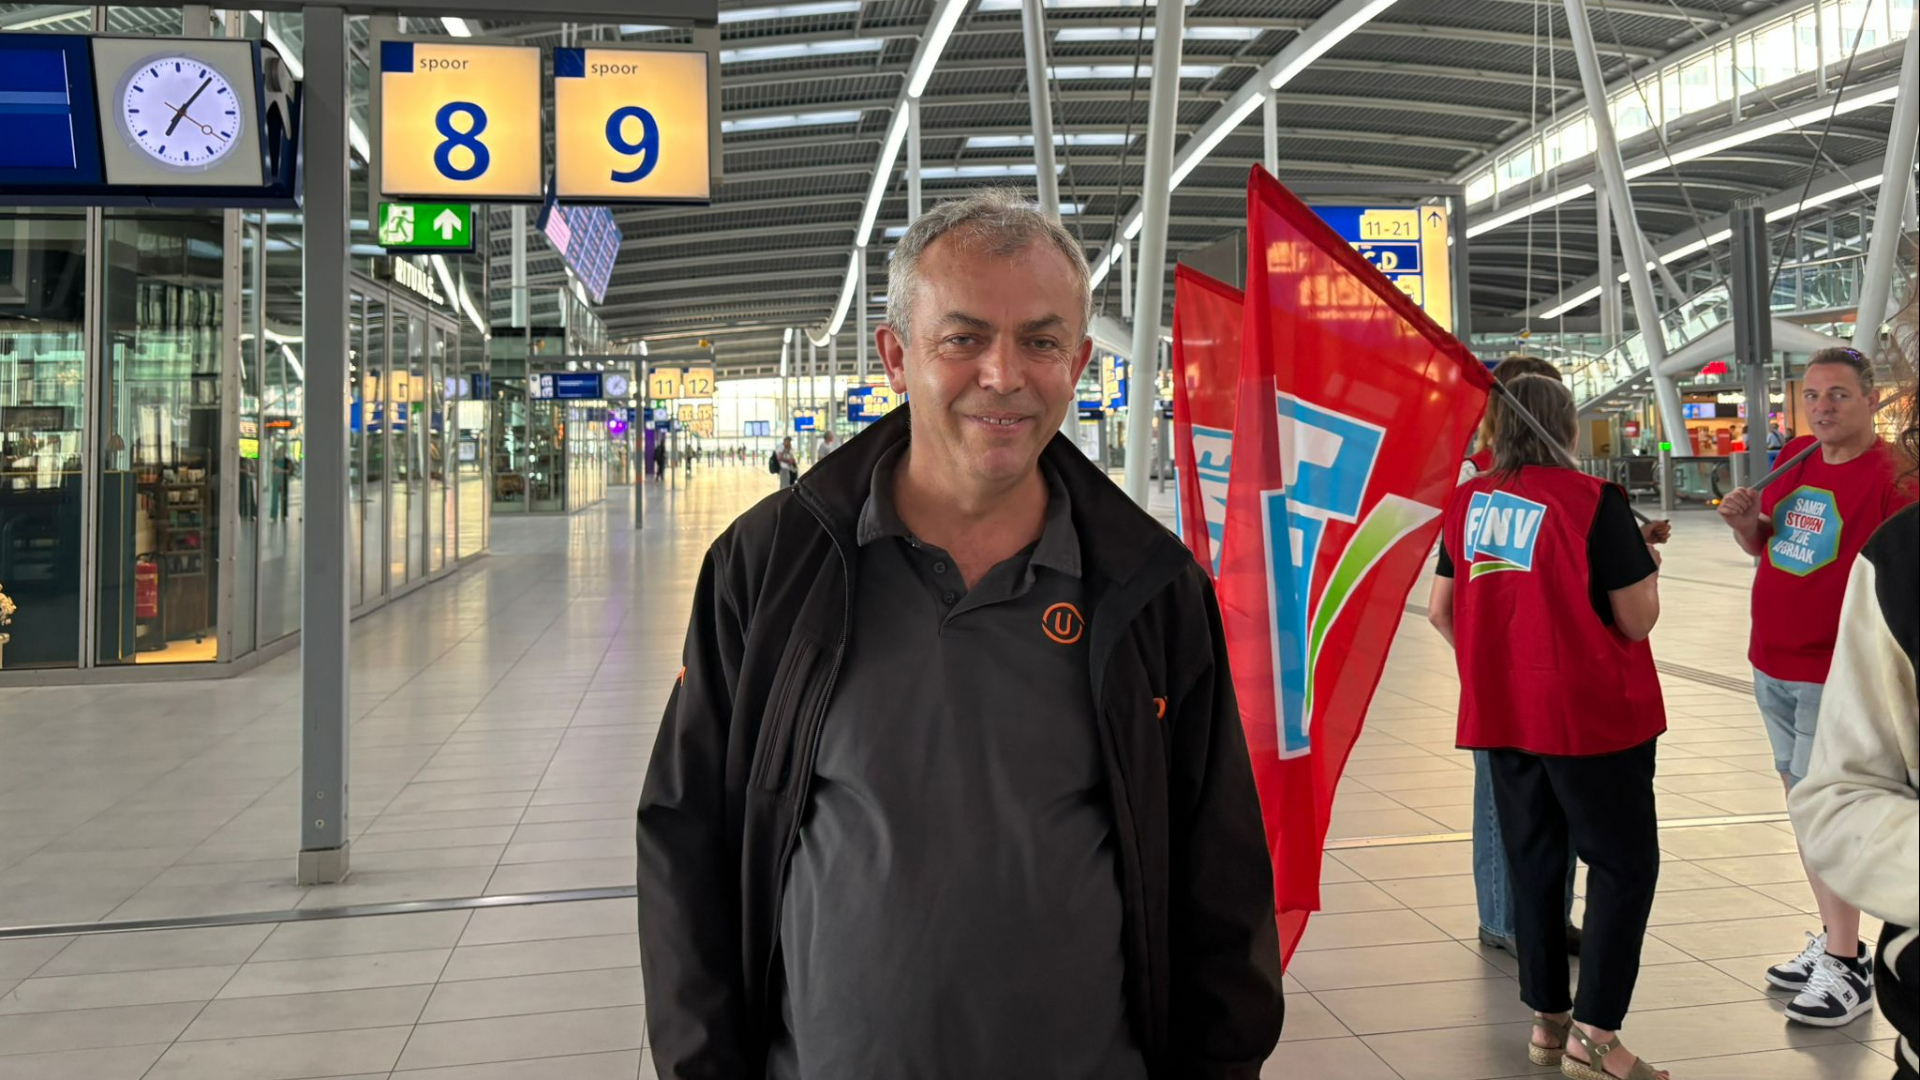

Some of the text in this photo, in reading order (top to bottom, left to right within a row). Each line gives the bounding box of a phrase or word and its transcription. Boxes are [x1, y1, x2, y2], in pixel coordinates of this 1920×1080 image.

[419, 56, 469, 70] spoor
[591, 61, 638, 76] spoor
[433, 100, 491, 181] 8
[605, 105, 660, 183] 9
[1366, 221, 1411, 236] 11-21
[655, 379, 673, 395] 11
[688, 378, 710, 395] 12
[1467, 506, 1541, 549] FNV
[1055, 612, 1072, 635] U
